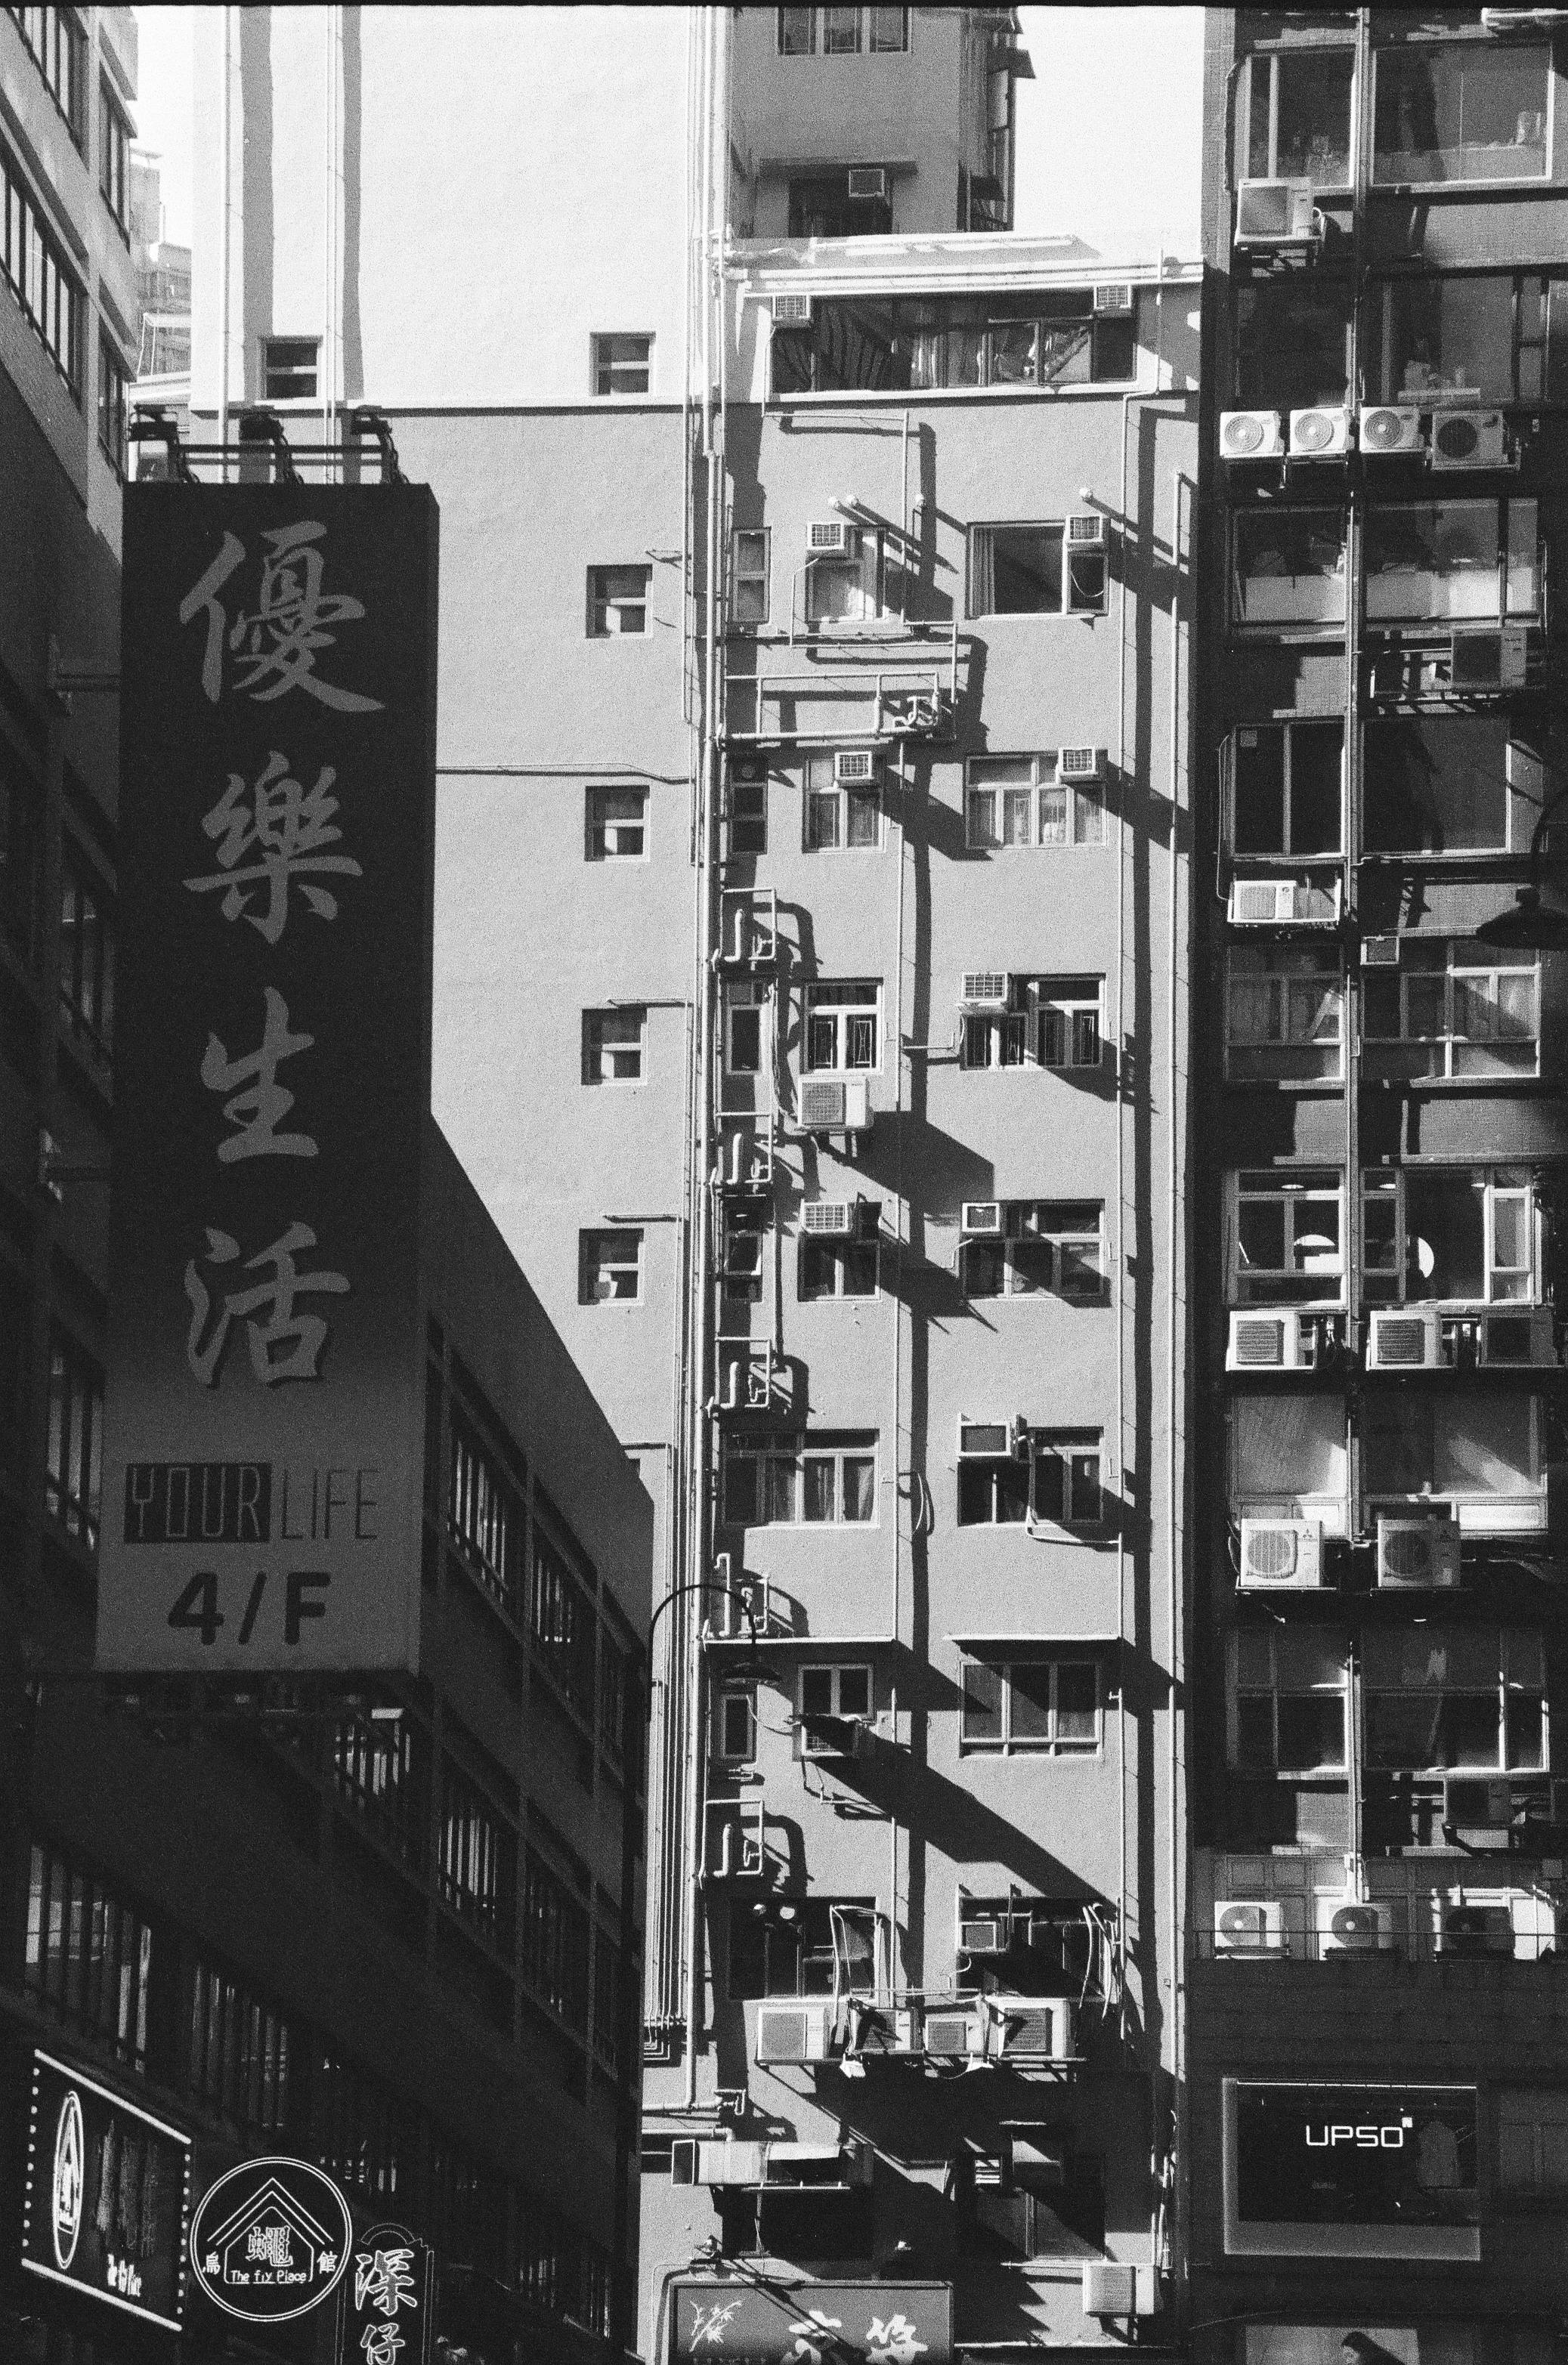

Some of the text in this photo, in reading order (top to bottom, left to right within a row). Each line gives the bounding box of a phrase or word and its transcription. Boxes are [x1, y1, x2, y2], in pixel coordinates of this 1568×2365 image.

[179, 521, 385, 1385] 優樂生活
[131, 1467, 379, 1540] YOUR LIFE
[169, 1572, 331, 1646] 4/F
[1306, 2125, 1403, 2147] UPSO
[230, 2270, 250, 2282] The
